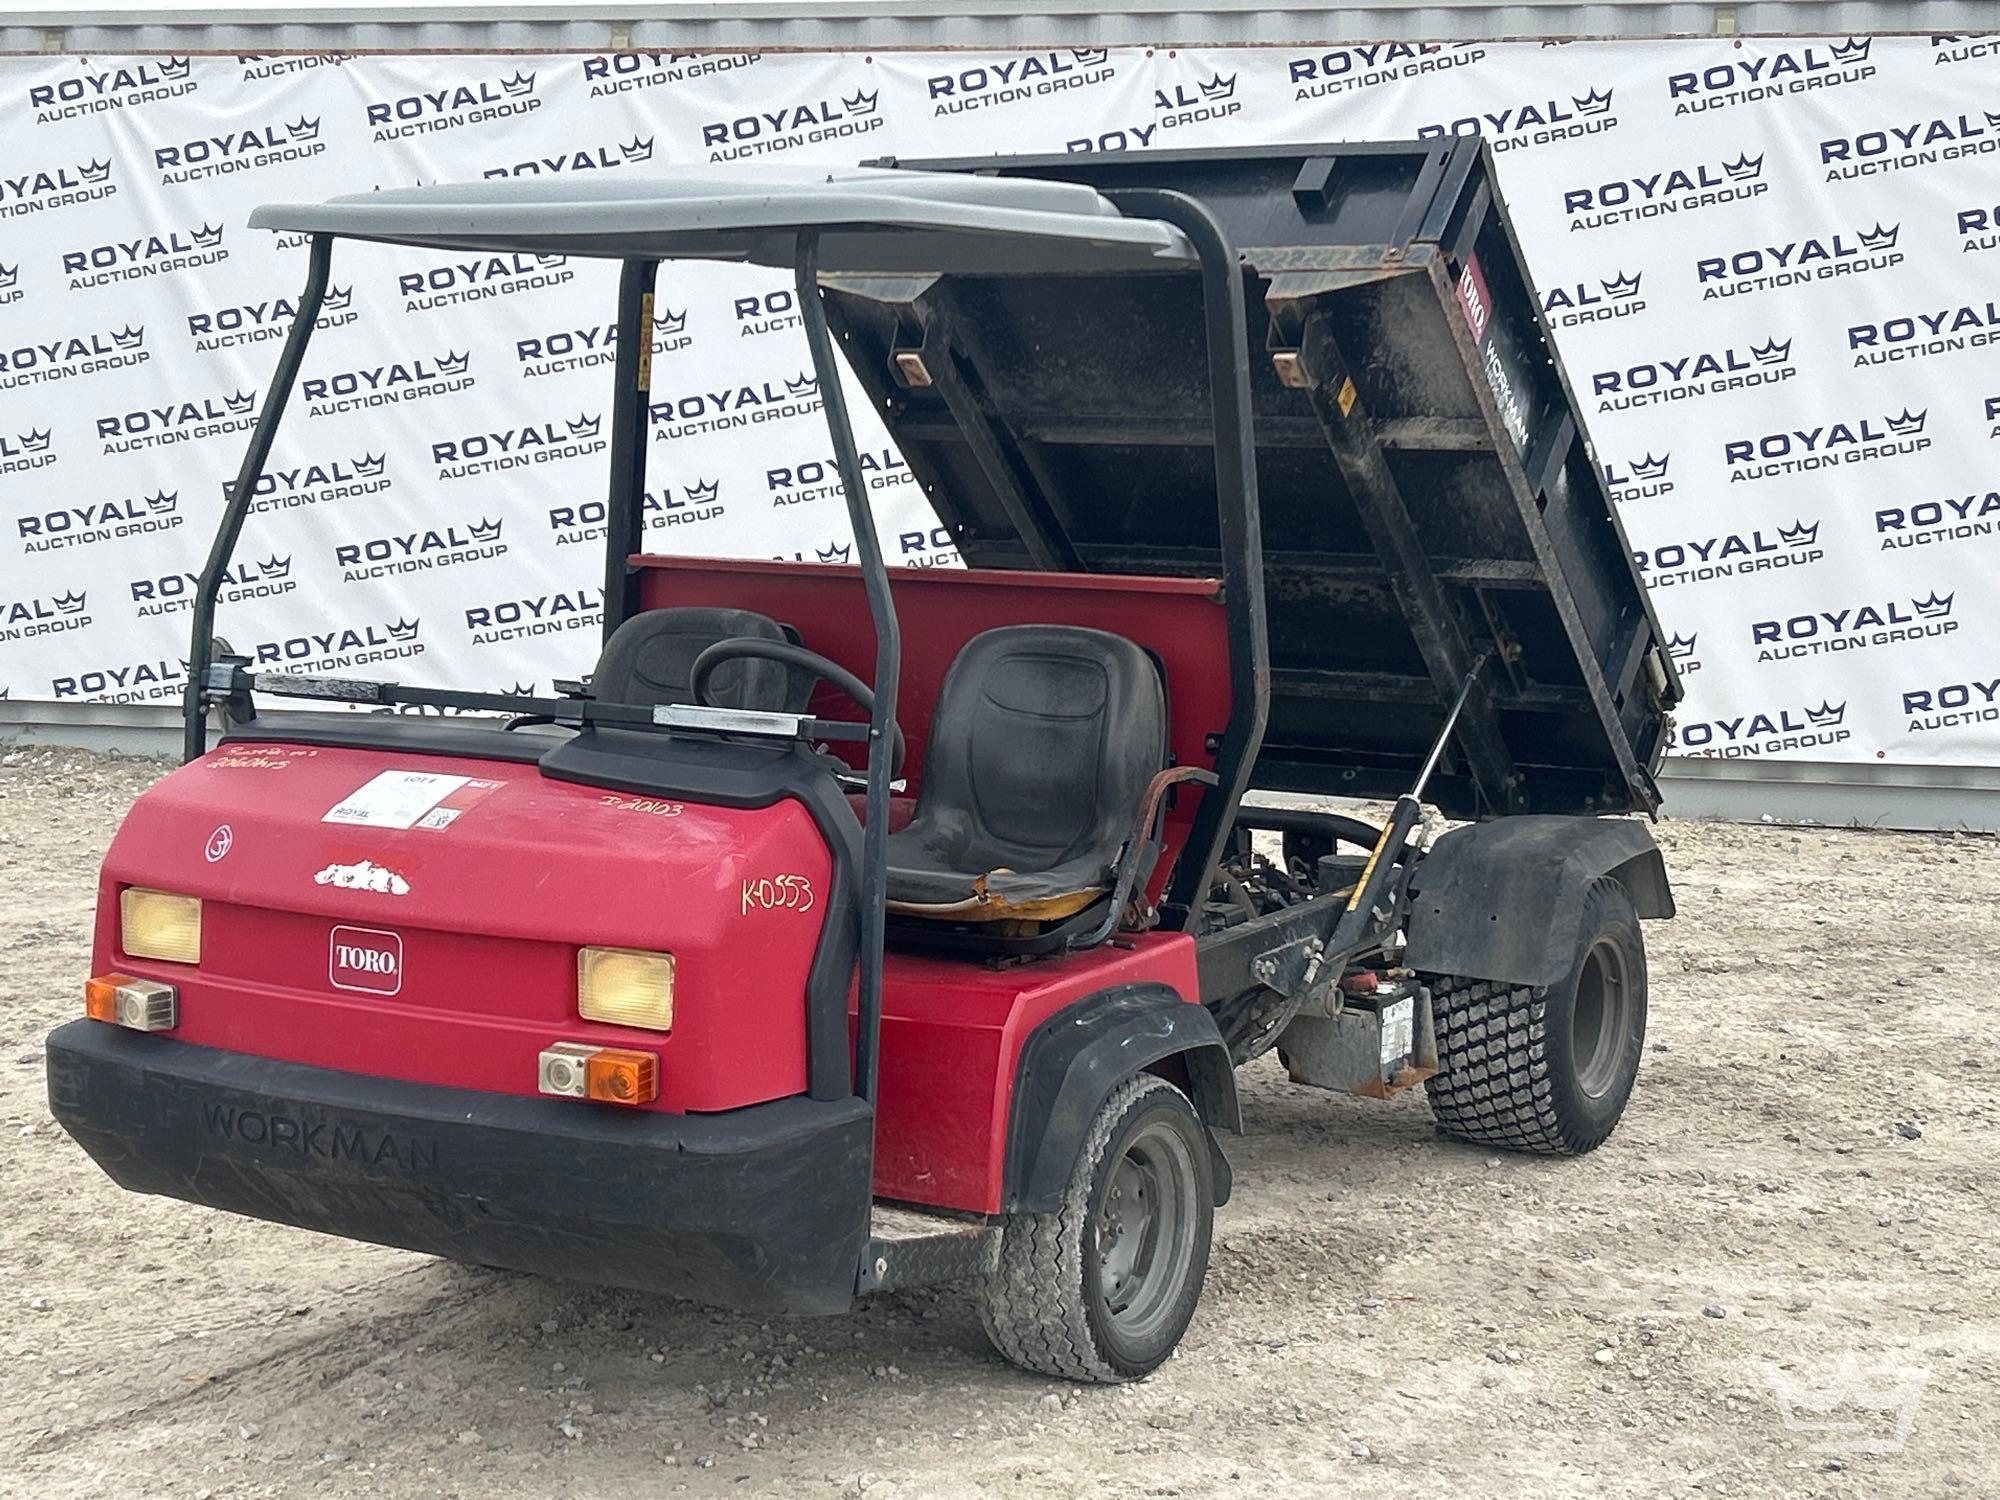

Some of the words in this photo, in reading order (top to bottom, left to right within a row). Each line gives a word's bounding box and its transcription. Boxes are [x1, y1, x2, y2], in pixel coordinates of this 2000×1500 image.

[1935, 41, 2000, 65] AUCT
[30, 66, 159, 107] ROYAL
[591, 69, 683, 98] AUCTION
[688, 53, 762, 77] GROUP
[928, 53, 1072, 99] ROYAL
[935, 86, 1031, 116] AUCTION
[1037, 69, 1114, 94] GROUP
[1296, 68, 1398, 101] AUCTION
[1403, 50, 1485, 77] GROUP
[1669, 49, 1829, 98] ROYAL
[1675, 84, 1783, 116] AUCTION
[1789, 66, 1875, 93] GROUP
[37, 97, 122, 124] AUCTION
[128, 82, 197, 105] GROUP
[367, 83, 501, 126] ROYAL
[374, 115, 464, 142] AUCTION
[469, 99, 541, 123] GROUP
[1162, 102, 1241, 128] GROUP
[703, 102, 842, 146] ROYAL
[710, 135, 803, 163] AUCTION
[809, 118, 883, 142] GROUP
[1534, 118, 1617, 144] GROUP
[1820, 115, 1984, 164] ROYAL
[155, 127, 287, 169] ROYAL
[163, 158, 250, 185] AUCTION
[255, 143, 325, 166] GROUP
[1826, 151, 1937, 182] AUCTION
[1943, 138, 2000, 159] GRO
[0, 169, 79, 201] YAL
[0, 200, 43, 218] TION
[48, 185, 116, 207] GROUP
[1564, 166, 1722, 214] ROYAL
[1571, 201, 1677, 231] AUCTION
[1683, 183, 1768, 209] GROUP
[63, 233, 192, 274] ROYAL
[70, 264, 156, 290] AUCTION
[160, 250, 228, 272] GROUP
[1697, 236, 1857, 283] ROYAL
[399, 254, 533, 296] ROYAL
[406, 286, 496, 312] AUCTION
[501, 271, 573, 294] GROUP
[1703, 270, 1811, 300] AUCTION
[1817, 253, 1903, 279] GROUP
[188, 299, 298, 335] ROYA
[742, 316, 803, 336] AUCTI
[1563, 301, 1646, 327] GROUP
[196, 327, 282, 352] AUCTION
[517, 323, 615, 361] ROYA
[524, 352, 616, 377] AUCTION
[651, 336, 691, 355] OUP
[1854, 337, 1964, 367] AUCTION
[0, 365, 77, 390] UCTION
[82, 352, 149, 373] GROUP
[303, 361, 436, 401] ROYAL
[1593, 350, 1750, 396] ROYAL
[1599, 384, 1705, 413] AUCTION
[1711, 368, 1796, 392] GROUP
[310, 392, 398, 417] AUCTION
[404, 378, 474, 400] GROUP
[650, 383, 785, 425] ROYAL
[1485, 338, 1529, 446] WORKMAN
[97, 400, 225, 438] ROYAL
[104, 430, 189, 455] AUCTION
[194, 417, 260, 438] GROUP
[656, 415, 747, 441] AUCTION
[752, 400, 824, 423] GROUP
[432, 424, 567, 463] ROYAL
[439, 455, 529, 480] AUCTION
[535, 441, 606, 462] GROUP
[1725, 420, 1885, 465] ROYAL
[1731, 454, 1839, 482] AUCTION
[1845, 438, 1931, 463] GROUP
[0, 455, 56, 474] ROUP
[246, 492, 315, 514] UCTION
[321, 480, 391, 501] GROUP
[550, 489, 685, 529] ROAL
[774, 482, 846, 507] AUCTIO
[871, 472, 914, 489] GRO
[1611, 482, 1674, 503] ROUP
[18, 499, 146, 537] ROYAL
[652, 507, 724, 528] GROUP
[1876, 493, 2000, 532] ROYA
[25, 529, 111, 553] AUCTION
[115, 517, 183, 537] GROUP
[336, 528, 469, 566] ROYAL
[1881, 522, 1991, 550] AUCTION
[344, 558, 432, 582] AUCTION
[437, 545, 507, 566] GROUP
[1643, 565, 1732, 589] UCTION
[1738, 550, 1823, 573] GROUP
[138, 590, 224, 617] AUCTIN
[228, 582, 296, 601] GROUP
[466, 591, 599, 629] ROYAL
[25, 616, 92, 639] GROUP
[473, 621, 562, 645] AUCTION
[567, 613, 605, 629] GRO
[1752, 603, 1912, 645] ROYAL
[1758, 636, 1866, 662] AUCTION
[1872, 622, 1958, 644] GROUP
[257, 627, 387, 663] ROYAL
[266, 656, 351, 675] CTION
[355, 644, 424, 664] GROUP
[53, 662, 180, 698] ROYAL
[150, 683, 187, 698] GRO
[1903, 679, 2000, 714] ROY
[1682, 711, 1804, 746] OYAL
[1909, 708, 2000, 732] AUCTIO
[1766, 730, 1850, 752] GROUP
[336, 945, 395, 974] TORO
[203, 1102, 439, 1171] WORKMAN
